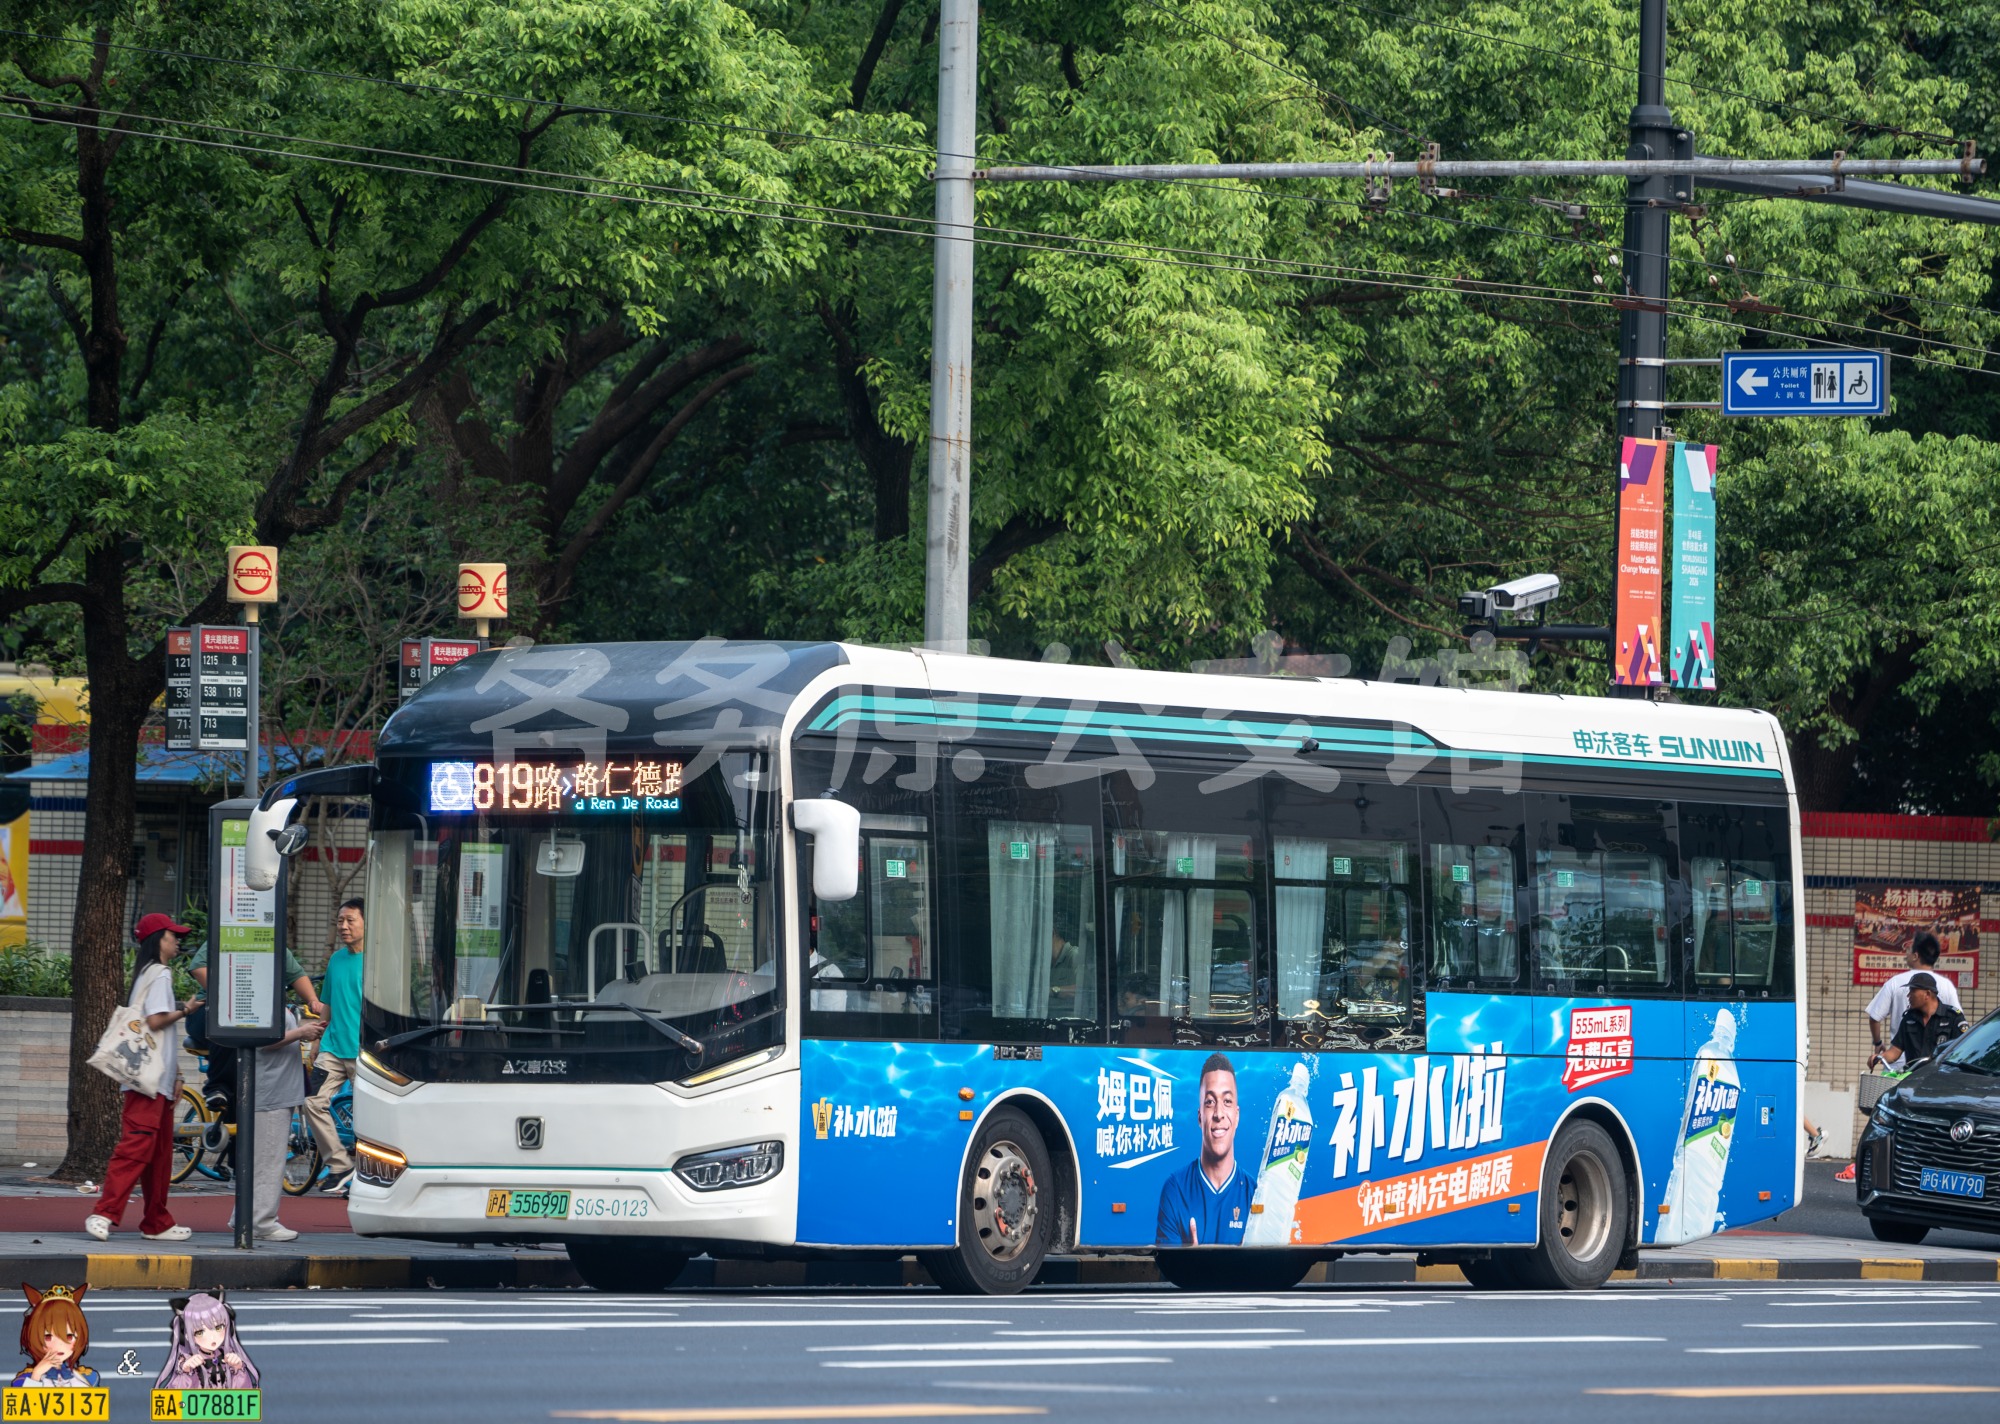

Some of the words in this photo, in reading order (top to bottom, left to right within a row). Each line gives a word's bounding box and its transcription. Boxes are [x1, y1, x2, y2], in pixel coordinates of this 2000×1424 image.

[1630, 554, 1645, 564] Master
[1645, 555, 1657, 565] Skills
[1681, 554, 1708, 565] WORLDSKILLS
[1620, 563, 1638, 576] Change
[1638, 564, 1650, 575] Your
[1681, 565, 1708, 577] SHANGHAI
[204, 634, 239, 645] 黄兴路国权路
[175, 657, 191, 668] 121
[202, 655, 219, 666] 1215
[231, 655, 238, 666] 8
[203, 686, 217, 697] 538
[228, 686, 242, 698] 118
[203, 717, 217, 729] 713
[1572, 729, 1653, 757] 申沃客车
[1659, 735, 1765, 763] SUNWIN
[473, 762, 562, 810] 819路
[591, 797, 616, 810] Ren
[622, 797, 639, 810] De
[645, 797, 680, 810] Road
[233, 822, 241, 832] 8
[1884, 888, 1954, 908] 杨浦夜市
[226, 928, 245, 938] 118
[1574, 1013, 1628, 1034] 555mL系列
[1564, 1038, 1633, 1082] 免费乐享
[1096, 1067, 1174, 1121] 姆巴佩
[1694, 1080, 1739, 1116] 补水啦
[1329, 1040, 1507, 1179] 补水啦
[833, 1105, 898, 1137] 补水啦
[1274, 1118, 1312, 1147] 补水啦
[1096, 1123, 1174, 1158] 喊你补水啦
[1361, 1154, 1513, 1227] 快速补充电解质
